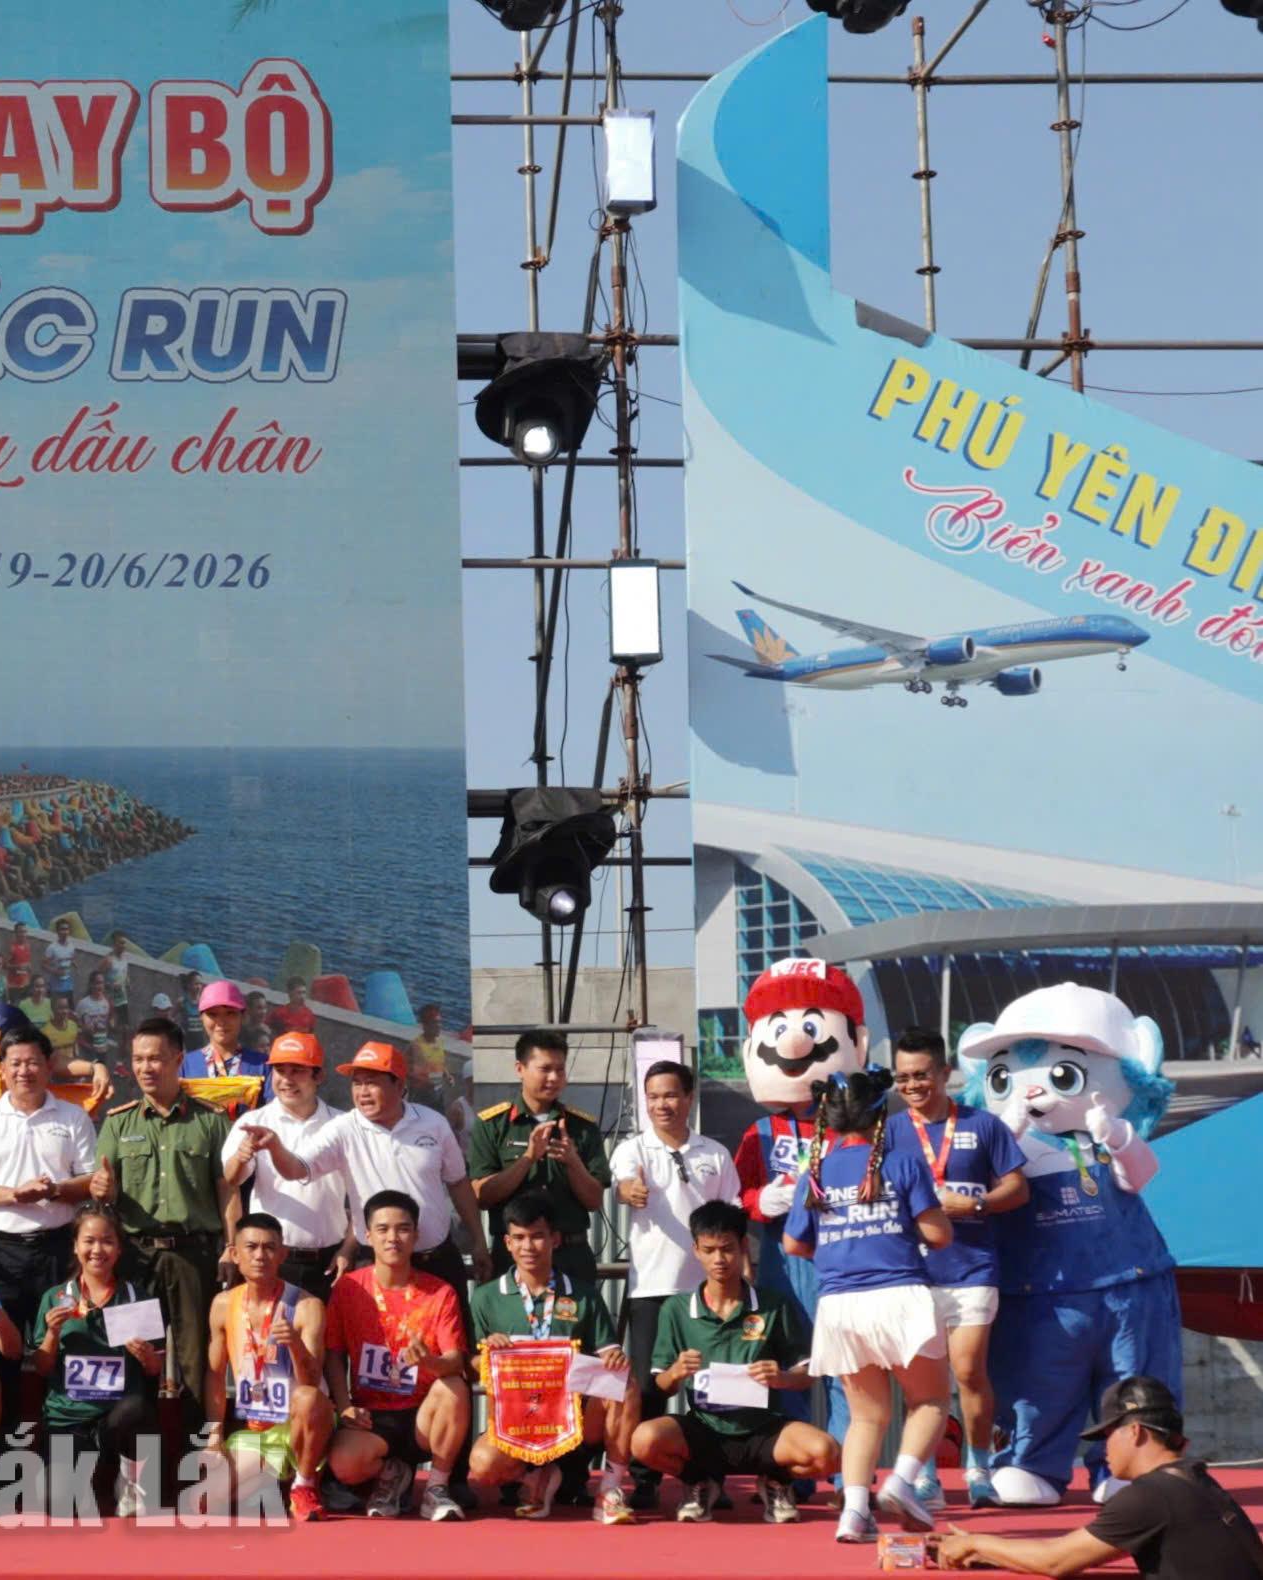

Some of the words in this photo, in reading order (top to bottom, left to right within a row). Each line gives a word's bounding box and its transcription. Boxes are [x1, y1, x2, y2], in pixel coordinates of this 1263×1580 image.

[162, 70, 320, 217] BỘ
[119, 297, 340, 375] RUN
[30, 401, 157, 473] dấu
[170, 406, 323, 474] chân
[868, 356, 1026, 471] PHÚ
[1035, 430, 1181, 549] YÊN
[1182, 505, 1263, 603] ĐI
[904, 467, 1064, 572] Biển
[1065, 558, 1192, 625] xanh
[848, 1201, 898, 1224] RUN
[67, 1359, 122, 1387] 277
